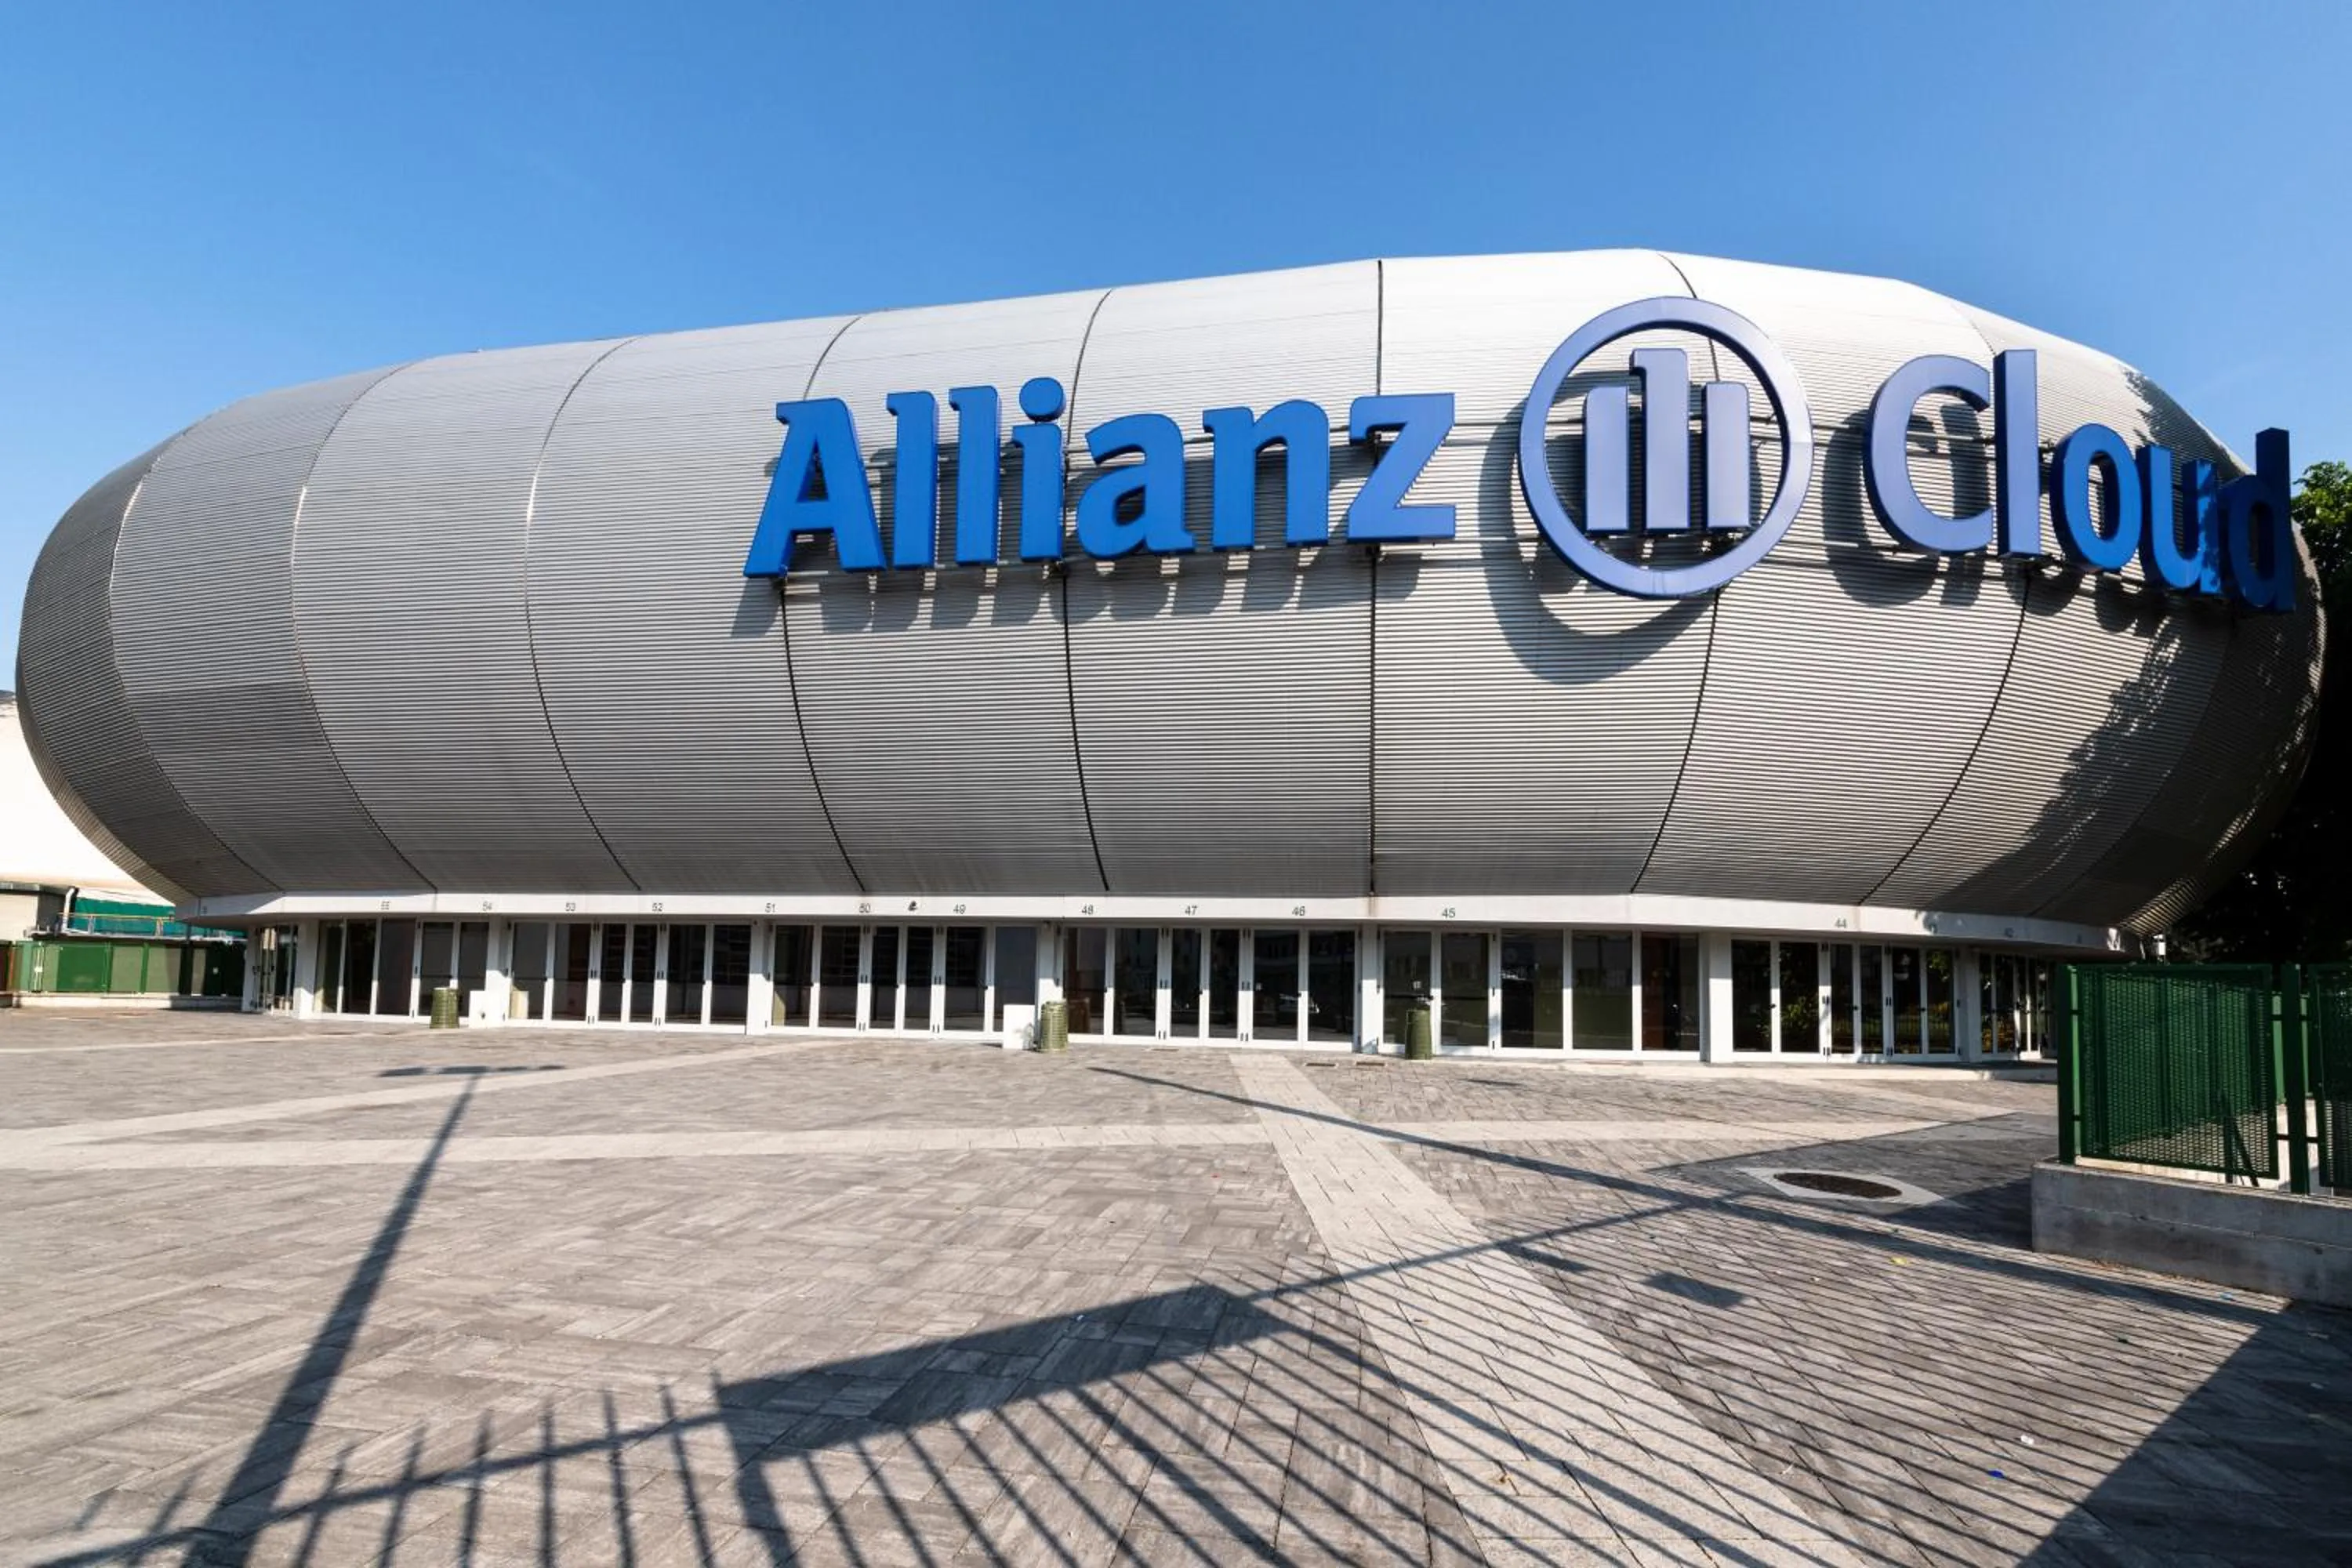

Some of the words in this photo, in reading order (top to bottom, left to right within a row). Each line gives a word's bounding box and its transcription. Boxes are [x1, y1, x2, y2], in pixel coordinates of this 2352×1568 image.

[743, 376, 1456, 579] Allianz
[1863, 349, 2296, 612] Cloud
[565, 902, 575, 912] 53
[652, 902, 662, 912] 52
[765, 902, 776, 913] 51
[859, 903, 871, 913] 50
[953, 904, 966, 914] 49
[1081, 904, 1094, 915] 48
[1185, 906, 1198, 916] 47
[1291, 906, 1305, 916] 46
[1442, 908, 1456, 918] 45
